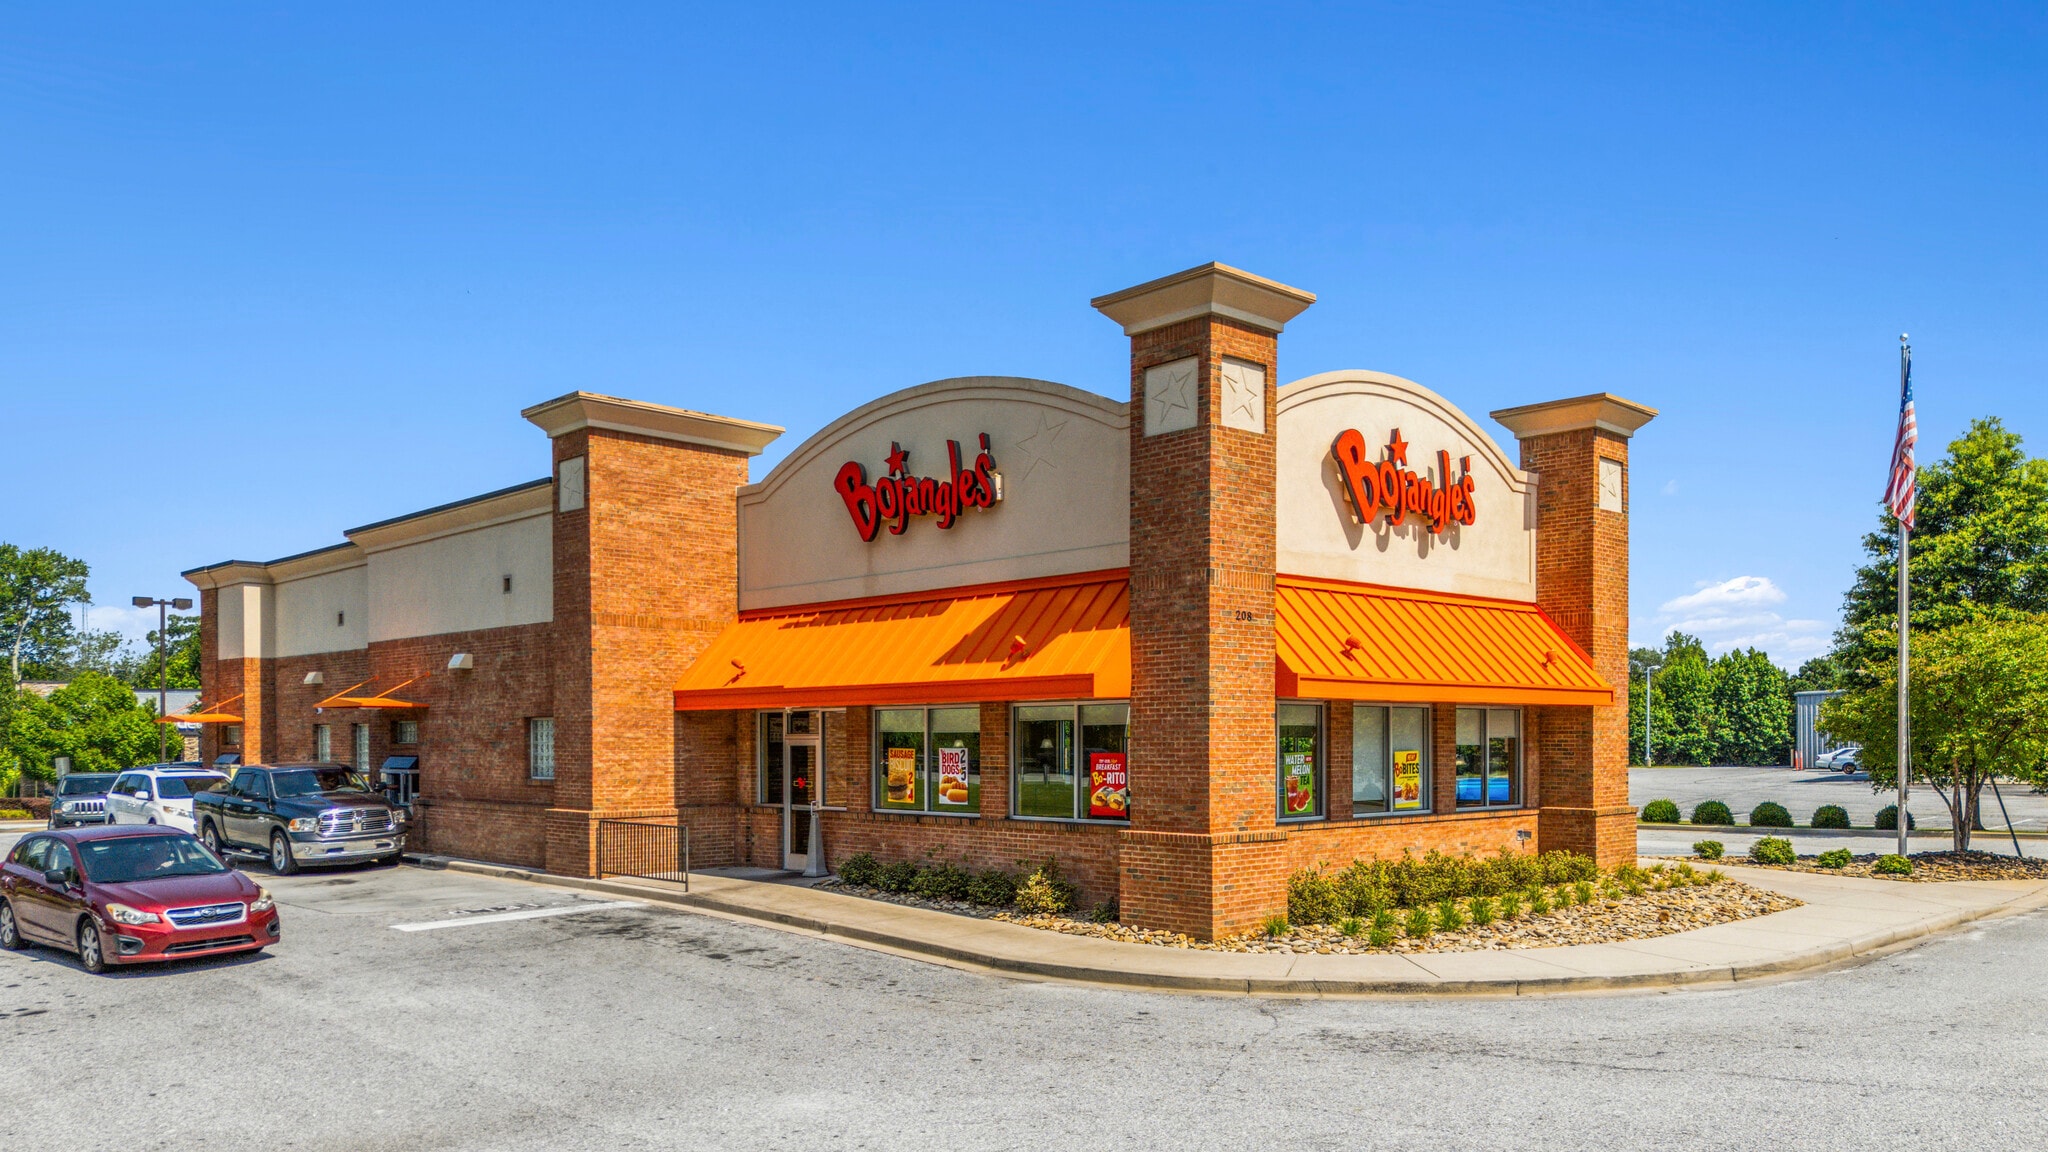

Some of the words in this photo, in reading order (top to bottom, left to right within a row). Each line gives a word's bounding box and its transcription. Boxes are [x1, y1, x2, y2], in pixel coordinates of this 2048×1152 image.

[1235, 610, 1252, 621] 208
[890, 749, 914, 759] SAUSAGE
[941, 752, 960, 764] BIRD
[960, 749, 966, 764] 2
[1286, 754, 1305, 765] WATER
[941, 764, 960, 775] DOGS
[961, 767, 966, 781] 5
[1292, 764, 1311, 774] MELON
[1402, 762, 1419, 774] BITES
[908, 772, 913, 784] 2
[1300, 776, 1310, 785] TEA
